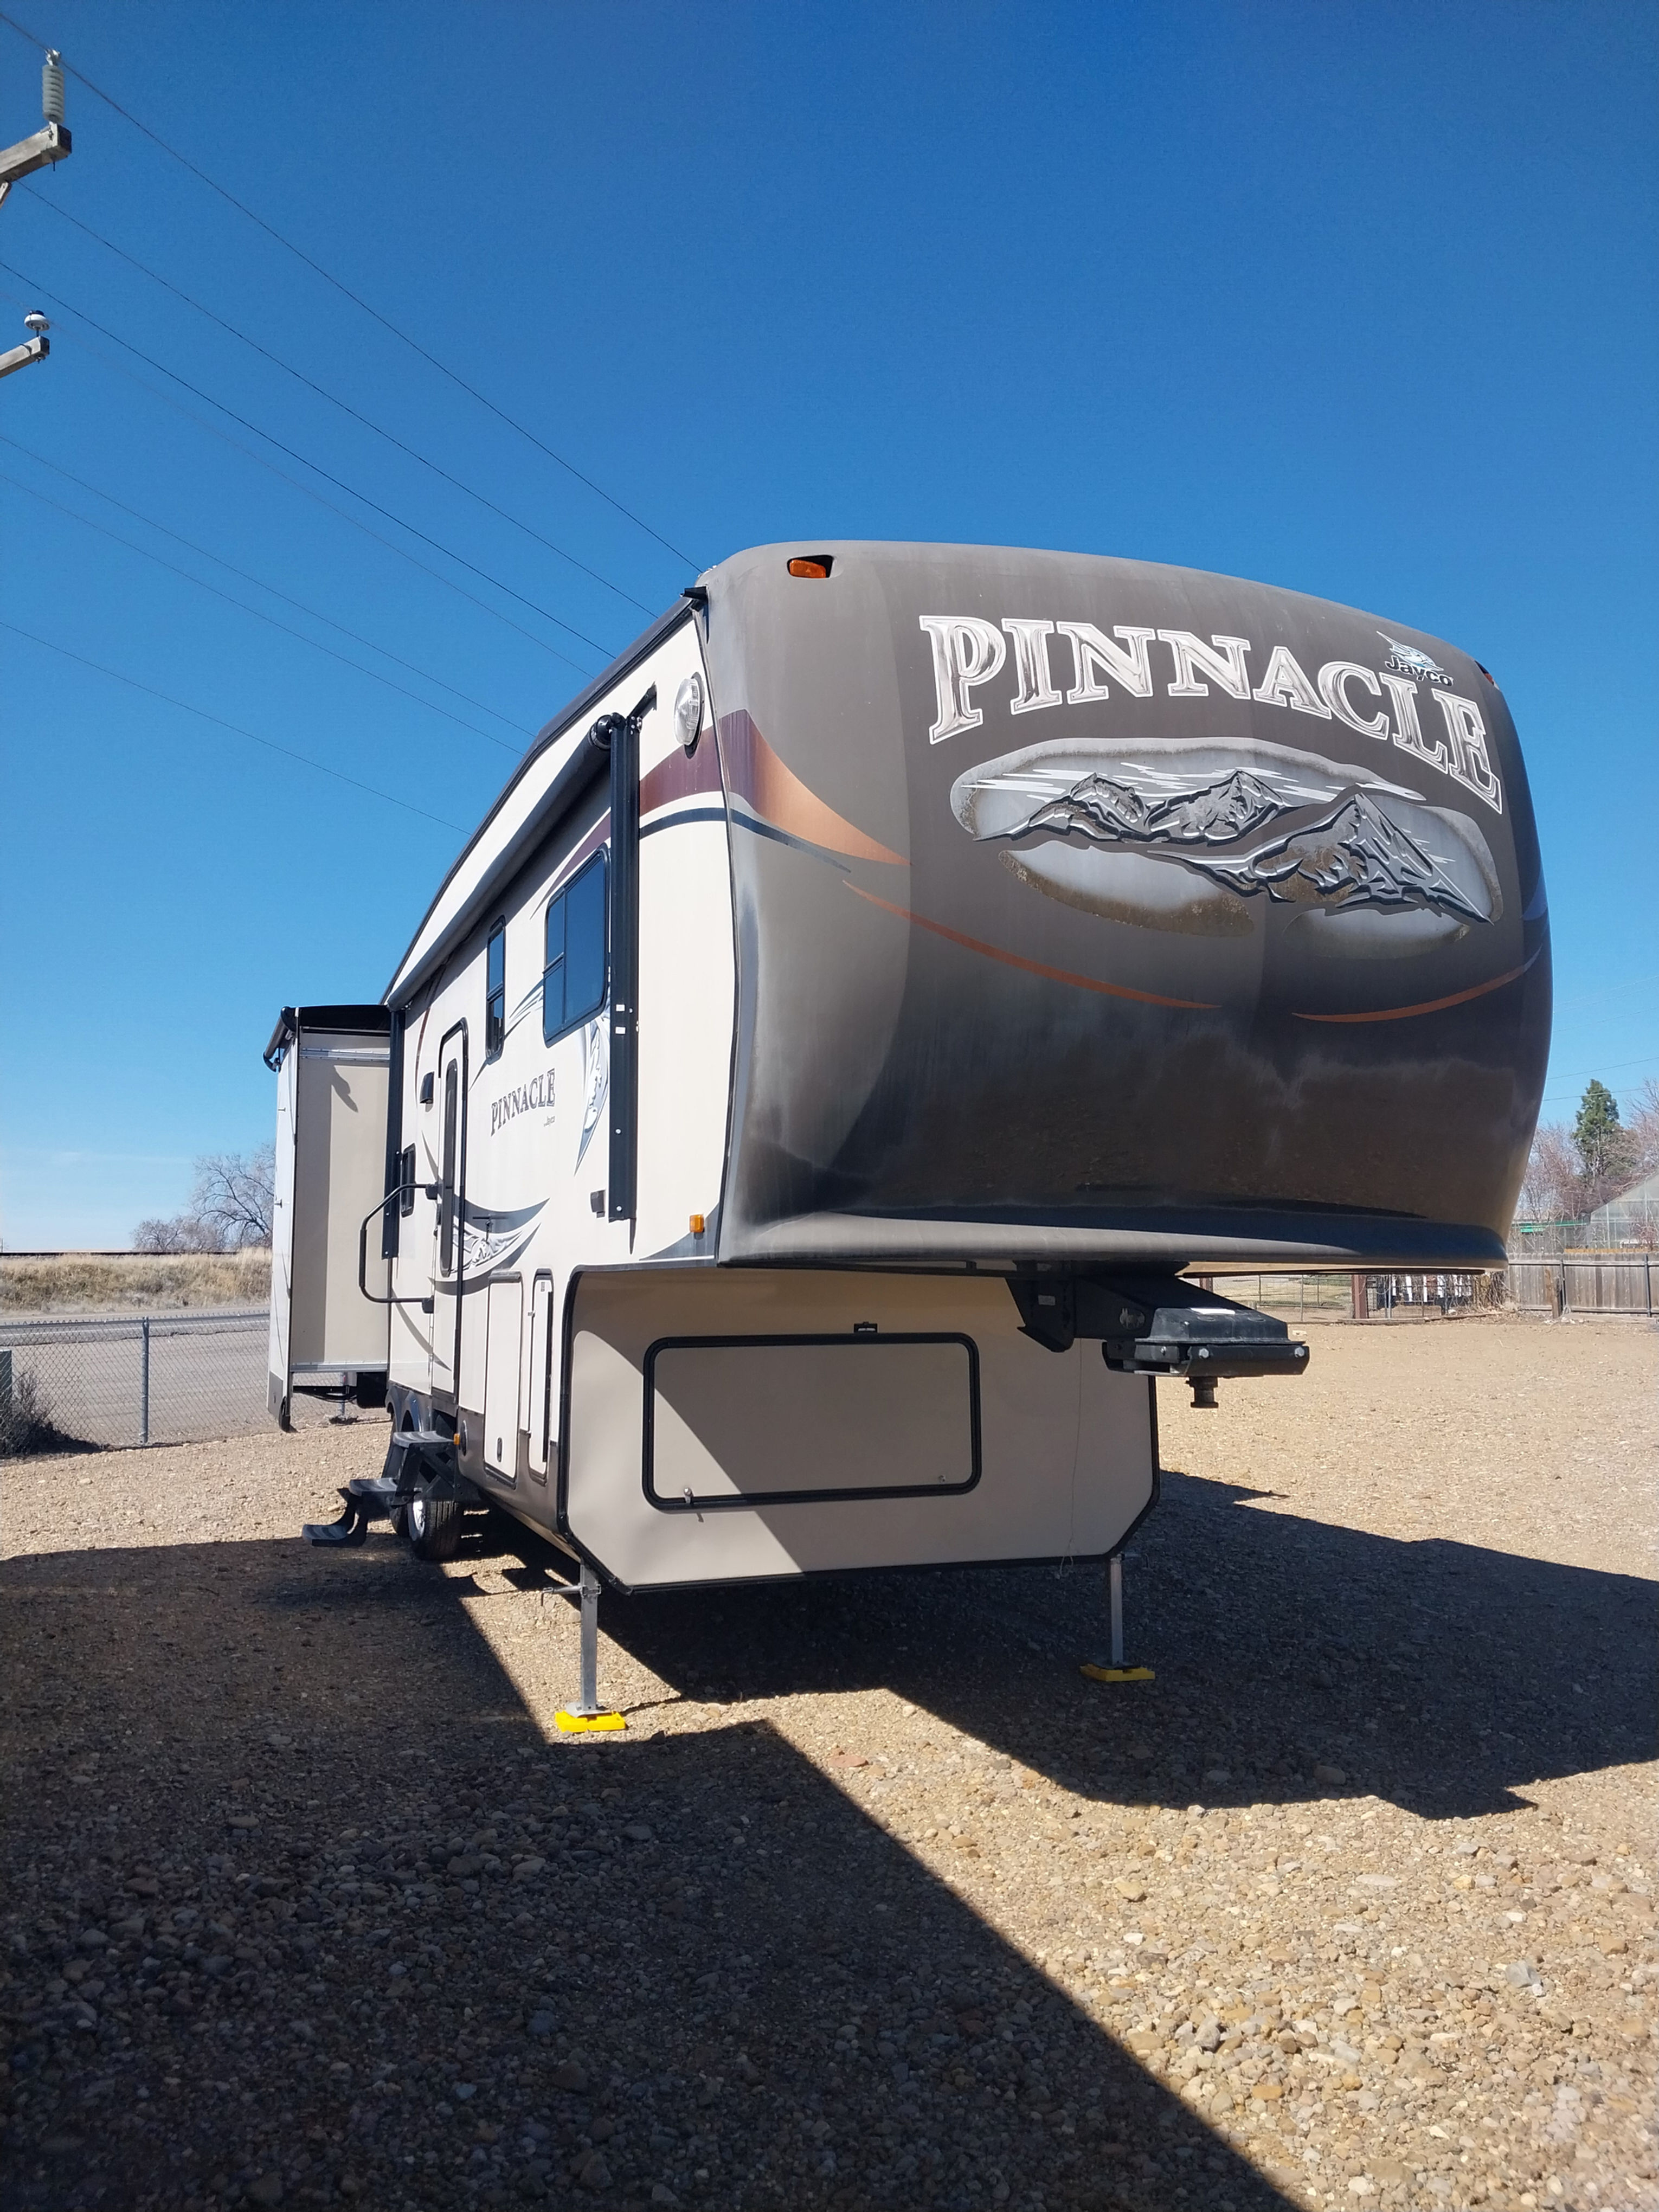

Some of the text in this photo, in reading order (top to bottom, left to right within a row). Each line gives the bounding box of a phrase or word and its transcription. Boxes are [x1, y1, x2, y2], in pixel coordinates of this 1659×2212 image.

[1385, 655, 1454, 686] Jayco
[919, 615, 1503, 813] PINNACLE
[491, 1068, 555, 1137] PINNACLE
